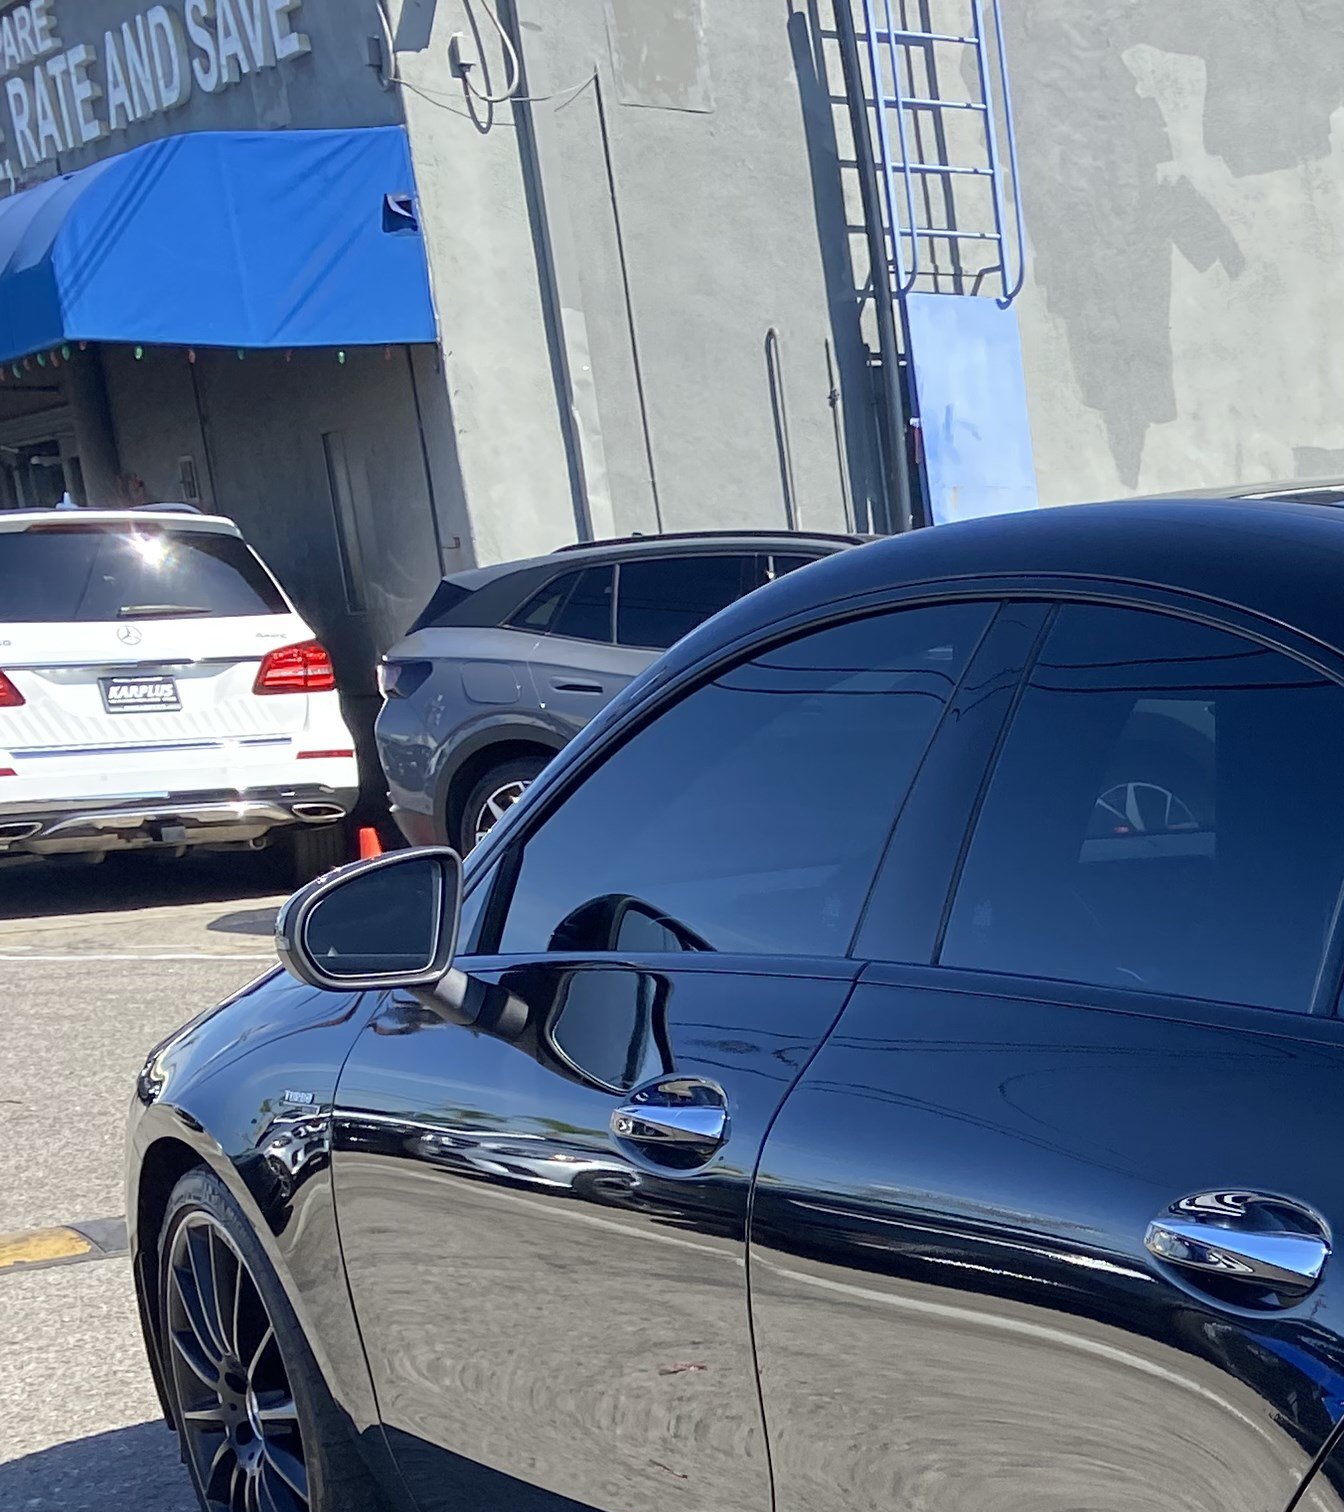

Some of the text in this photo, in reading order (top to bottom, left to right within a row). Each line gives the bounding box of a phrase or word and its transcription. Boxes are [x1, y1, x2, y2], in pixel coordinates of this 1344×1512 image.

[0, 0, 54, 70] ARE
[5, 0, 303, 169] RATE AND SAVE
[107, 683, 174, 699] KARPLUS
